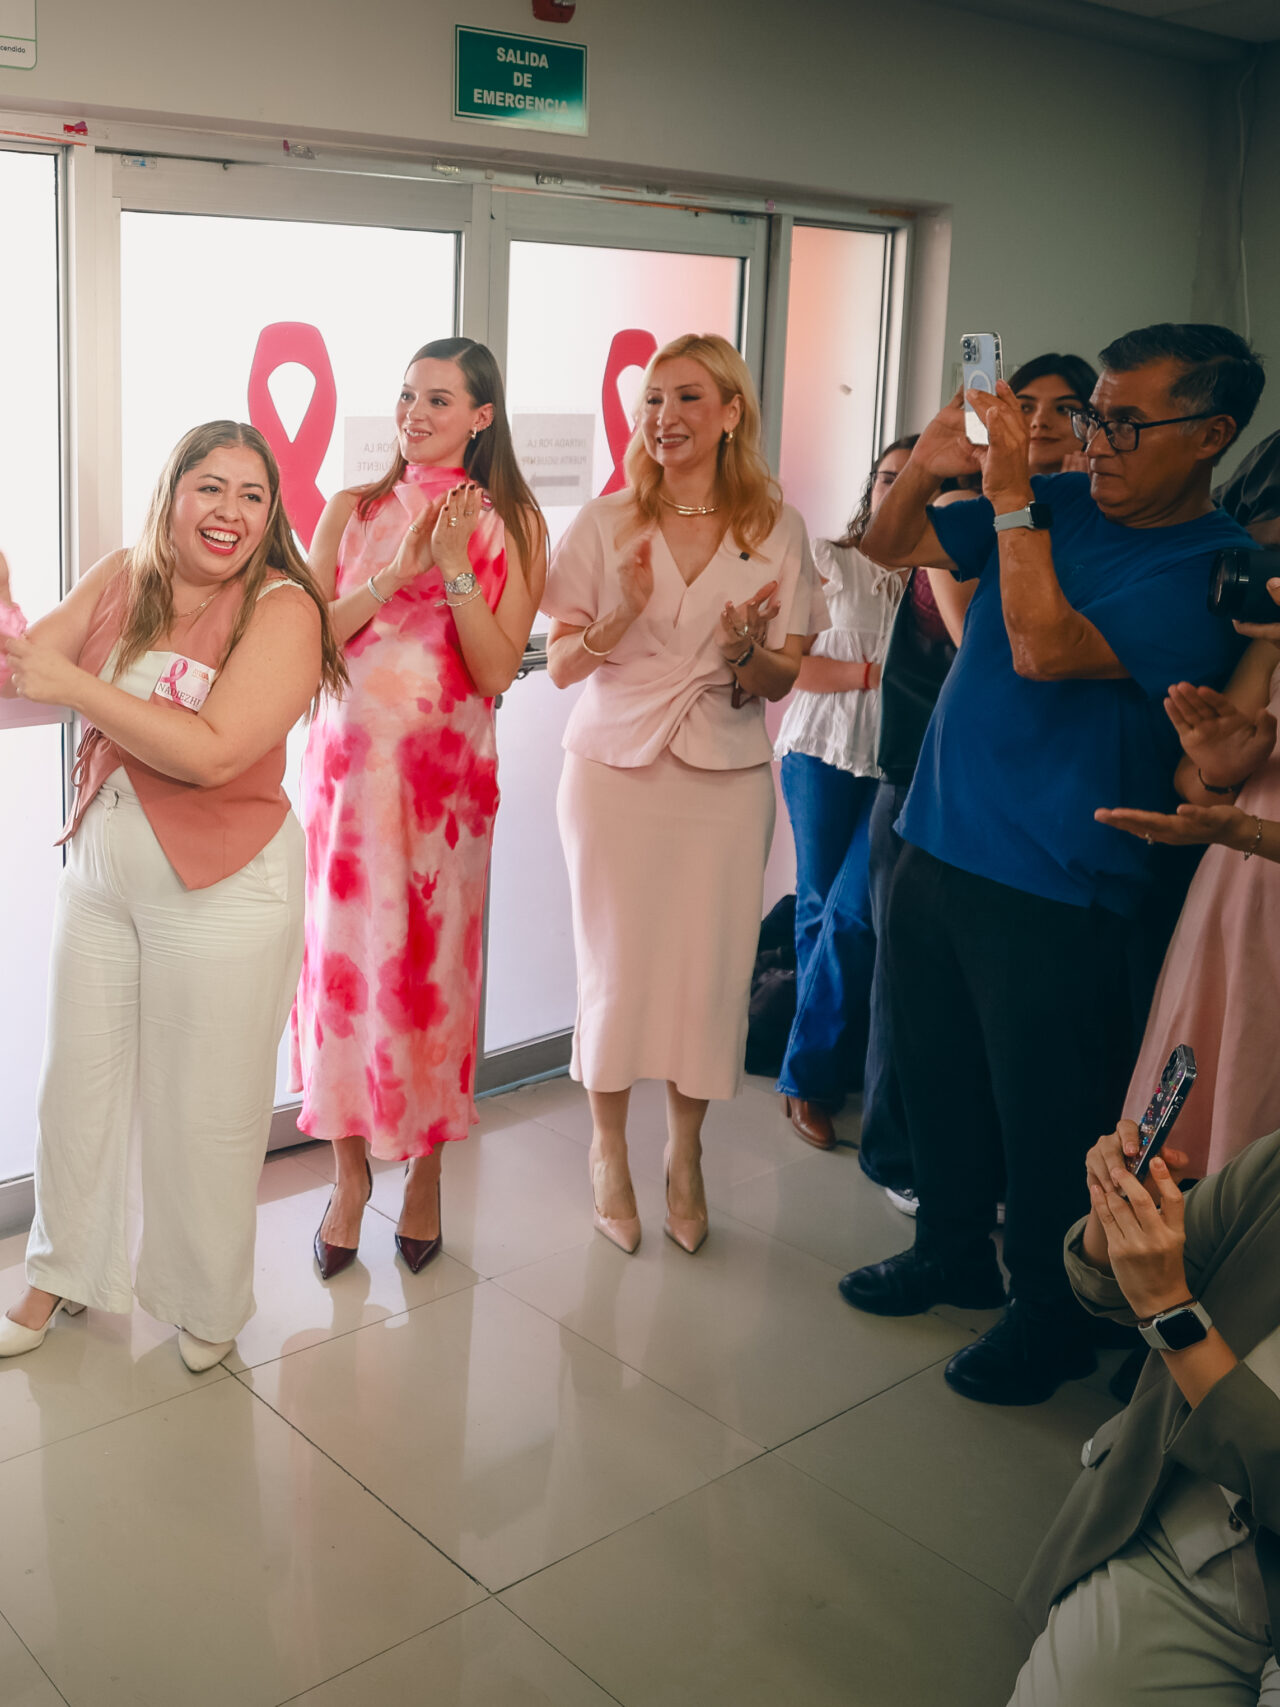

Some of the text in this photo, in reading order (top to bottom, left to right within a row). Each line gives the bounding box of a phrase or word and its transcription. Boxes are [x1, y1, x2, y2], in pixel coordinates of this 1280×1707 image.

[496, 47, 549, 68] SALIDA
[514, 72, 532, 88] DE
[474, 88, 568, 114] EMERGENCIA
